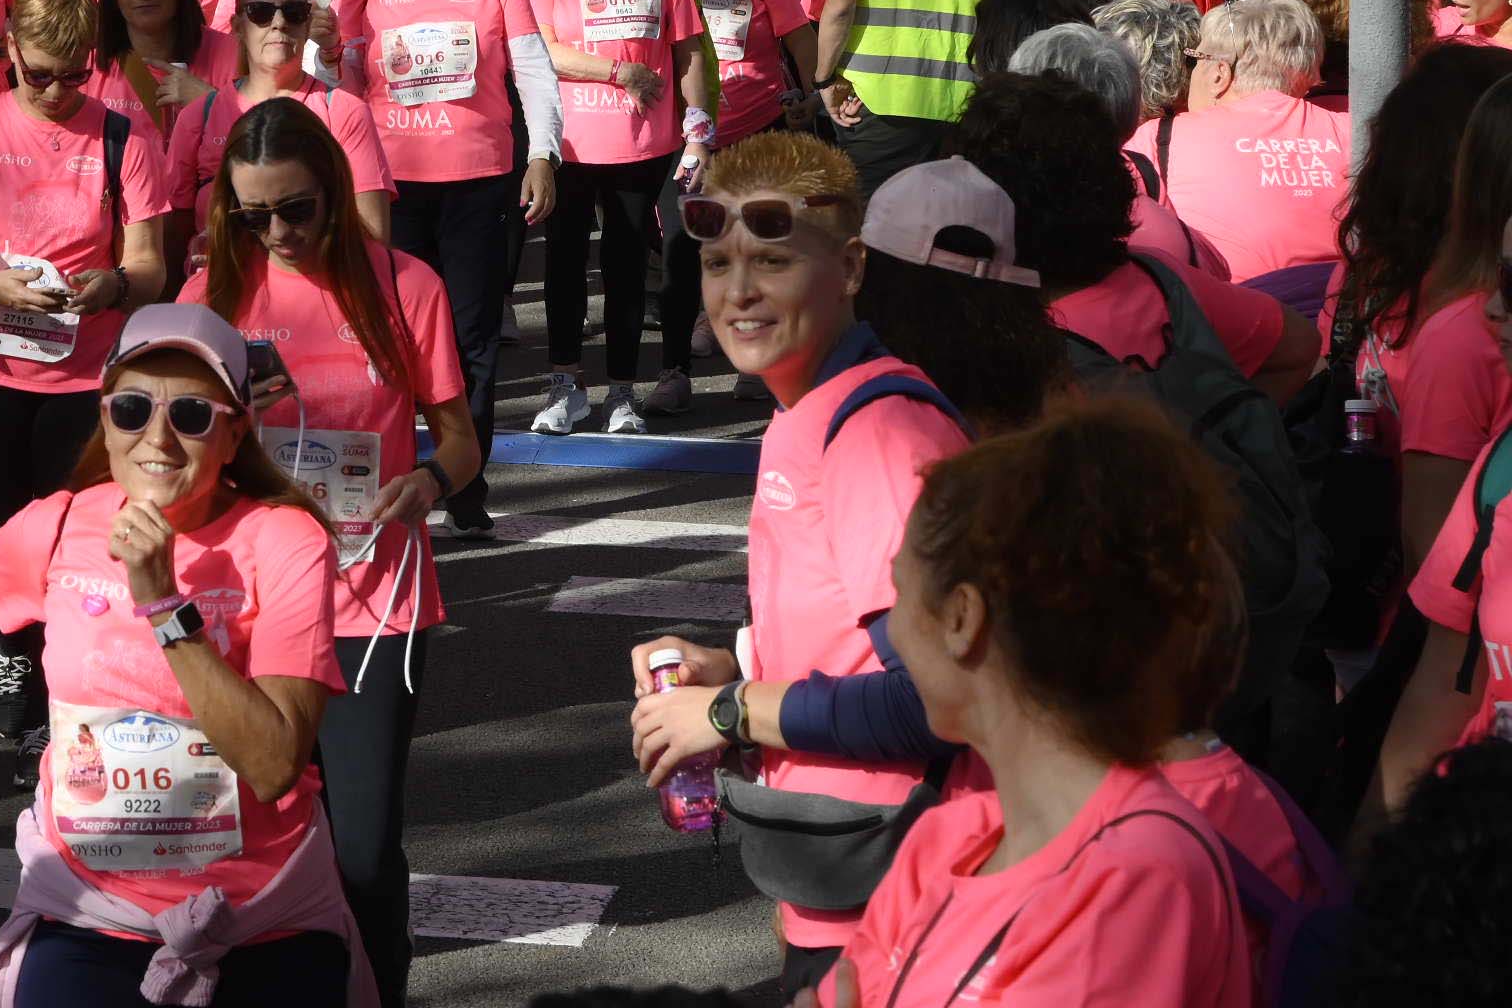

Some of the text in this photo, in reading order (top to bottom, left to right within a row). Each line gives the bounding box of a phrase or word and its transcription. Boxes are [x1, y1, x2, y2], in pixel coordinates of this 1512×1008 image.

[386, 109, 453, 129] SUMA
[1235, 137, 1341, 155] CARRERA
[1260, 153, 1327, 170] DE LA
[1260, 168, 1337, 189] MUJER
[1293, 189, 1313, 197] 2023
[3, 313, 35, 326] 27115
[343, 524, 362, 533] 2023
[59, 573, 131, 601] OYSHO
[110, 730, 174, 745] ASTURIANA
[112, 766, 173, 791] 016
[123, 799, 162, 814] 9222
[72, 819, 222, 832] CARRERA DE LA MUJER 2023
[70, 840, 229, 858] OYSHO Santander
